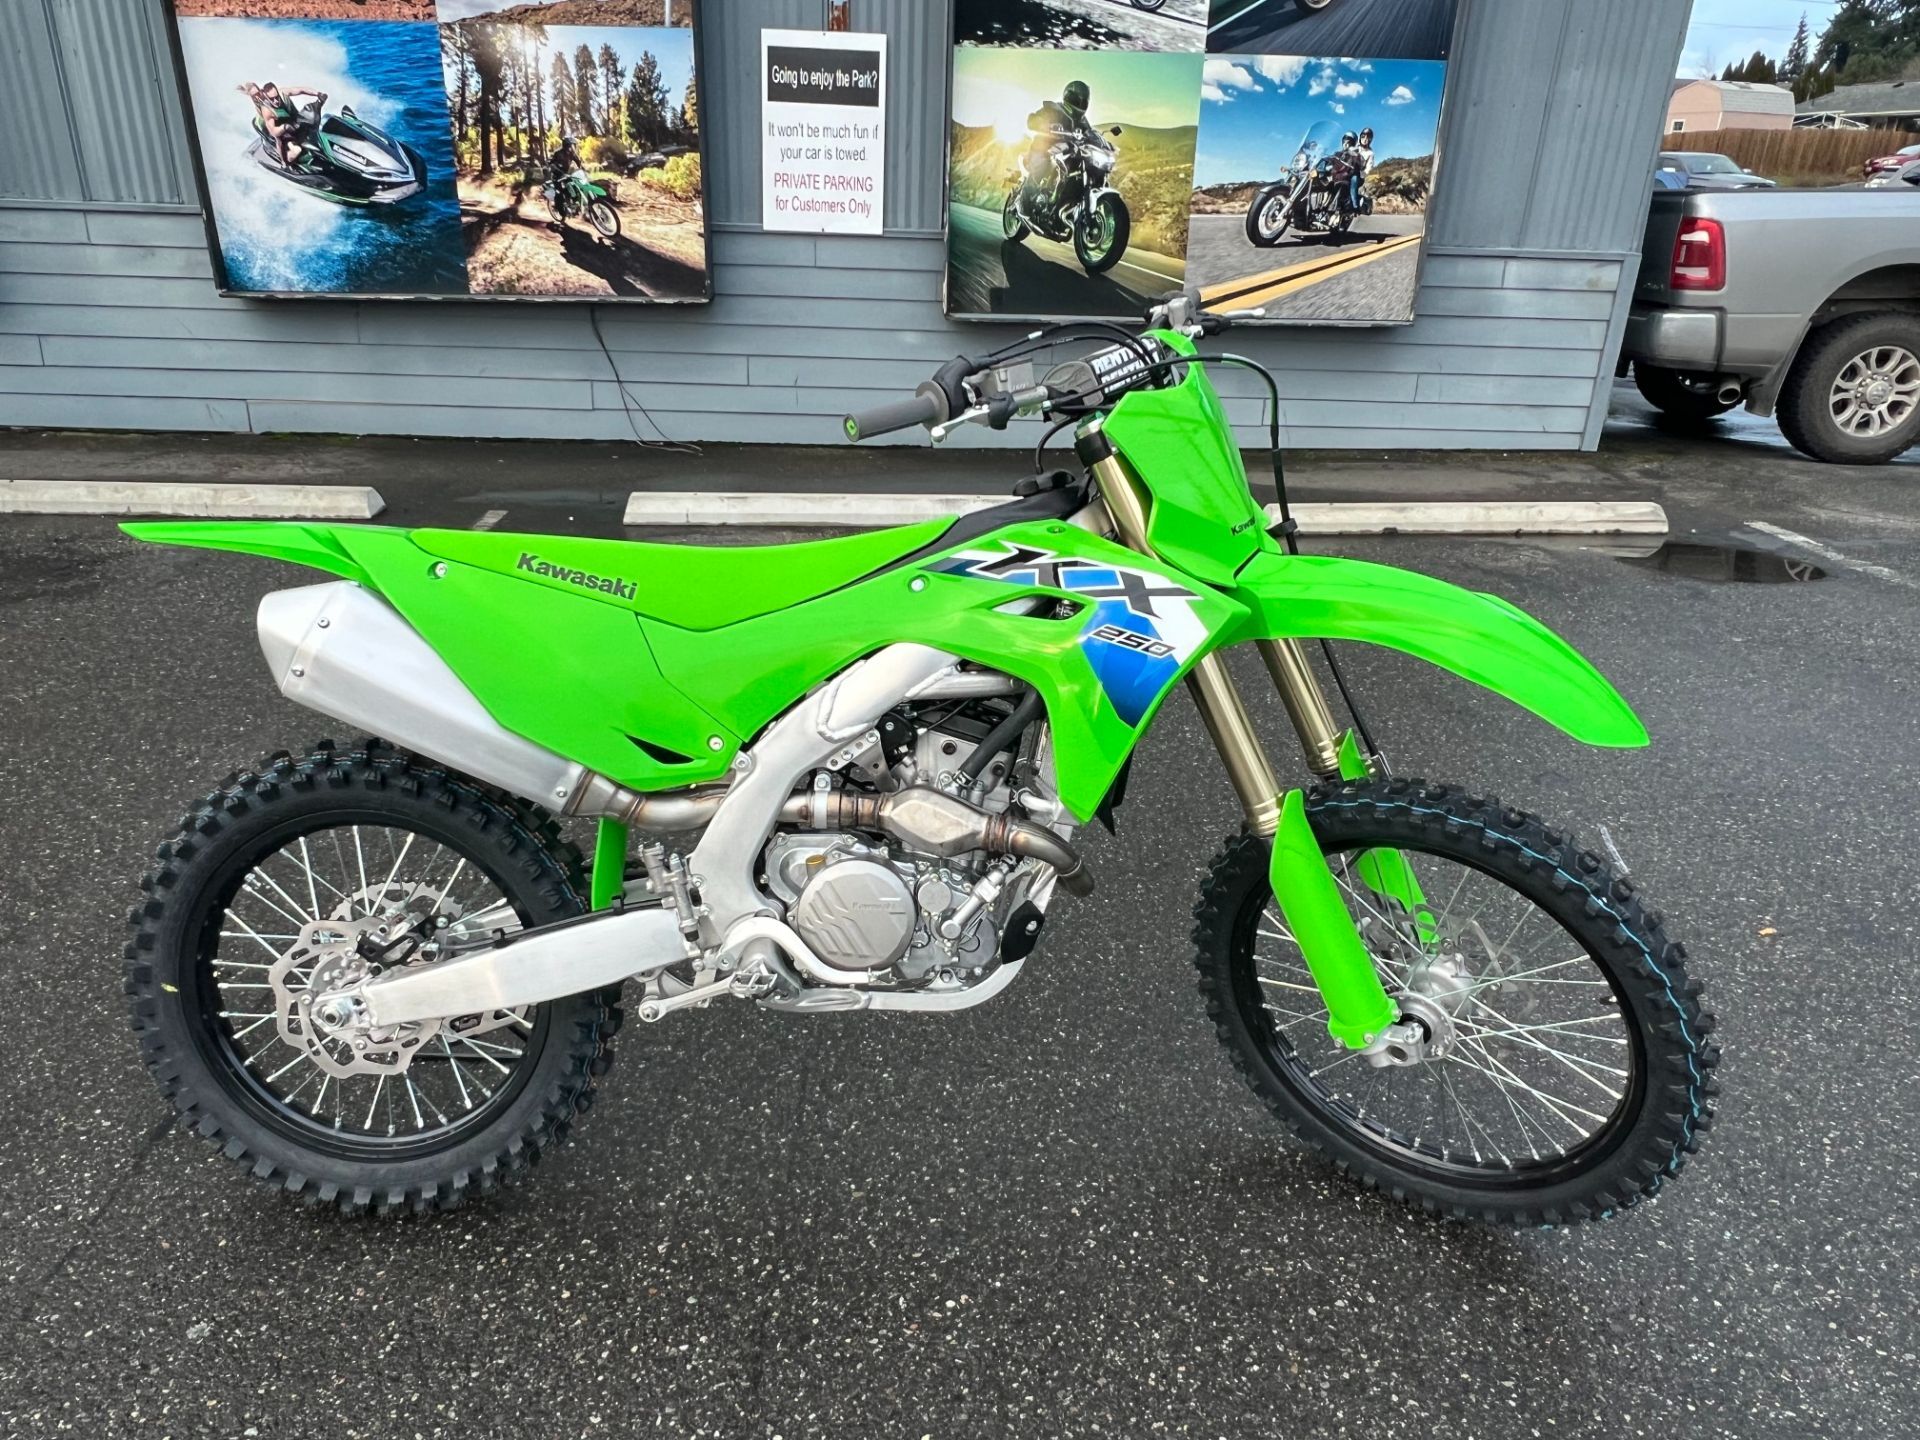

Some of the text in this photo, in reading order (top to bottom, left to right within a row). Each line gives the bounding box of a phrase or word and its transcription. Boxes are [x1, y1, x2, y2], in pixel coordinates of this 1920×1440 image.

[771, 65, 878, 91] Going to enjoy the Park?
[768, 121, 879, 140] It won't be much fun if
[780, 147, 803, 163] your
[805, 147, 821, 160] car
[824, 145, 833, 160] is
[774, 172, 873, 192] PRIVATE PARKING
[775, 195, 872, 218] for Customers Only
[516, 552, 638, 601] Kawasaki
[1091, 625, 1176, 657] 250
